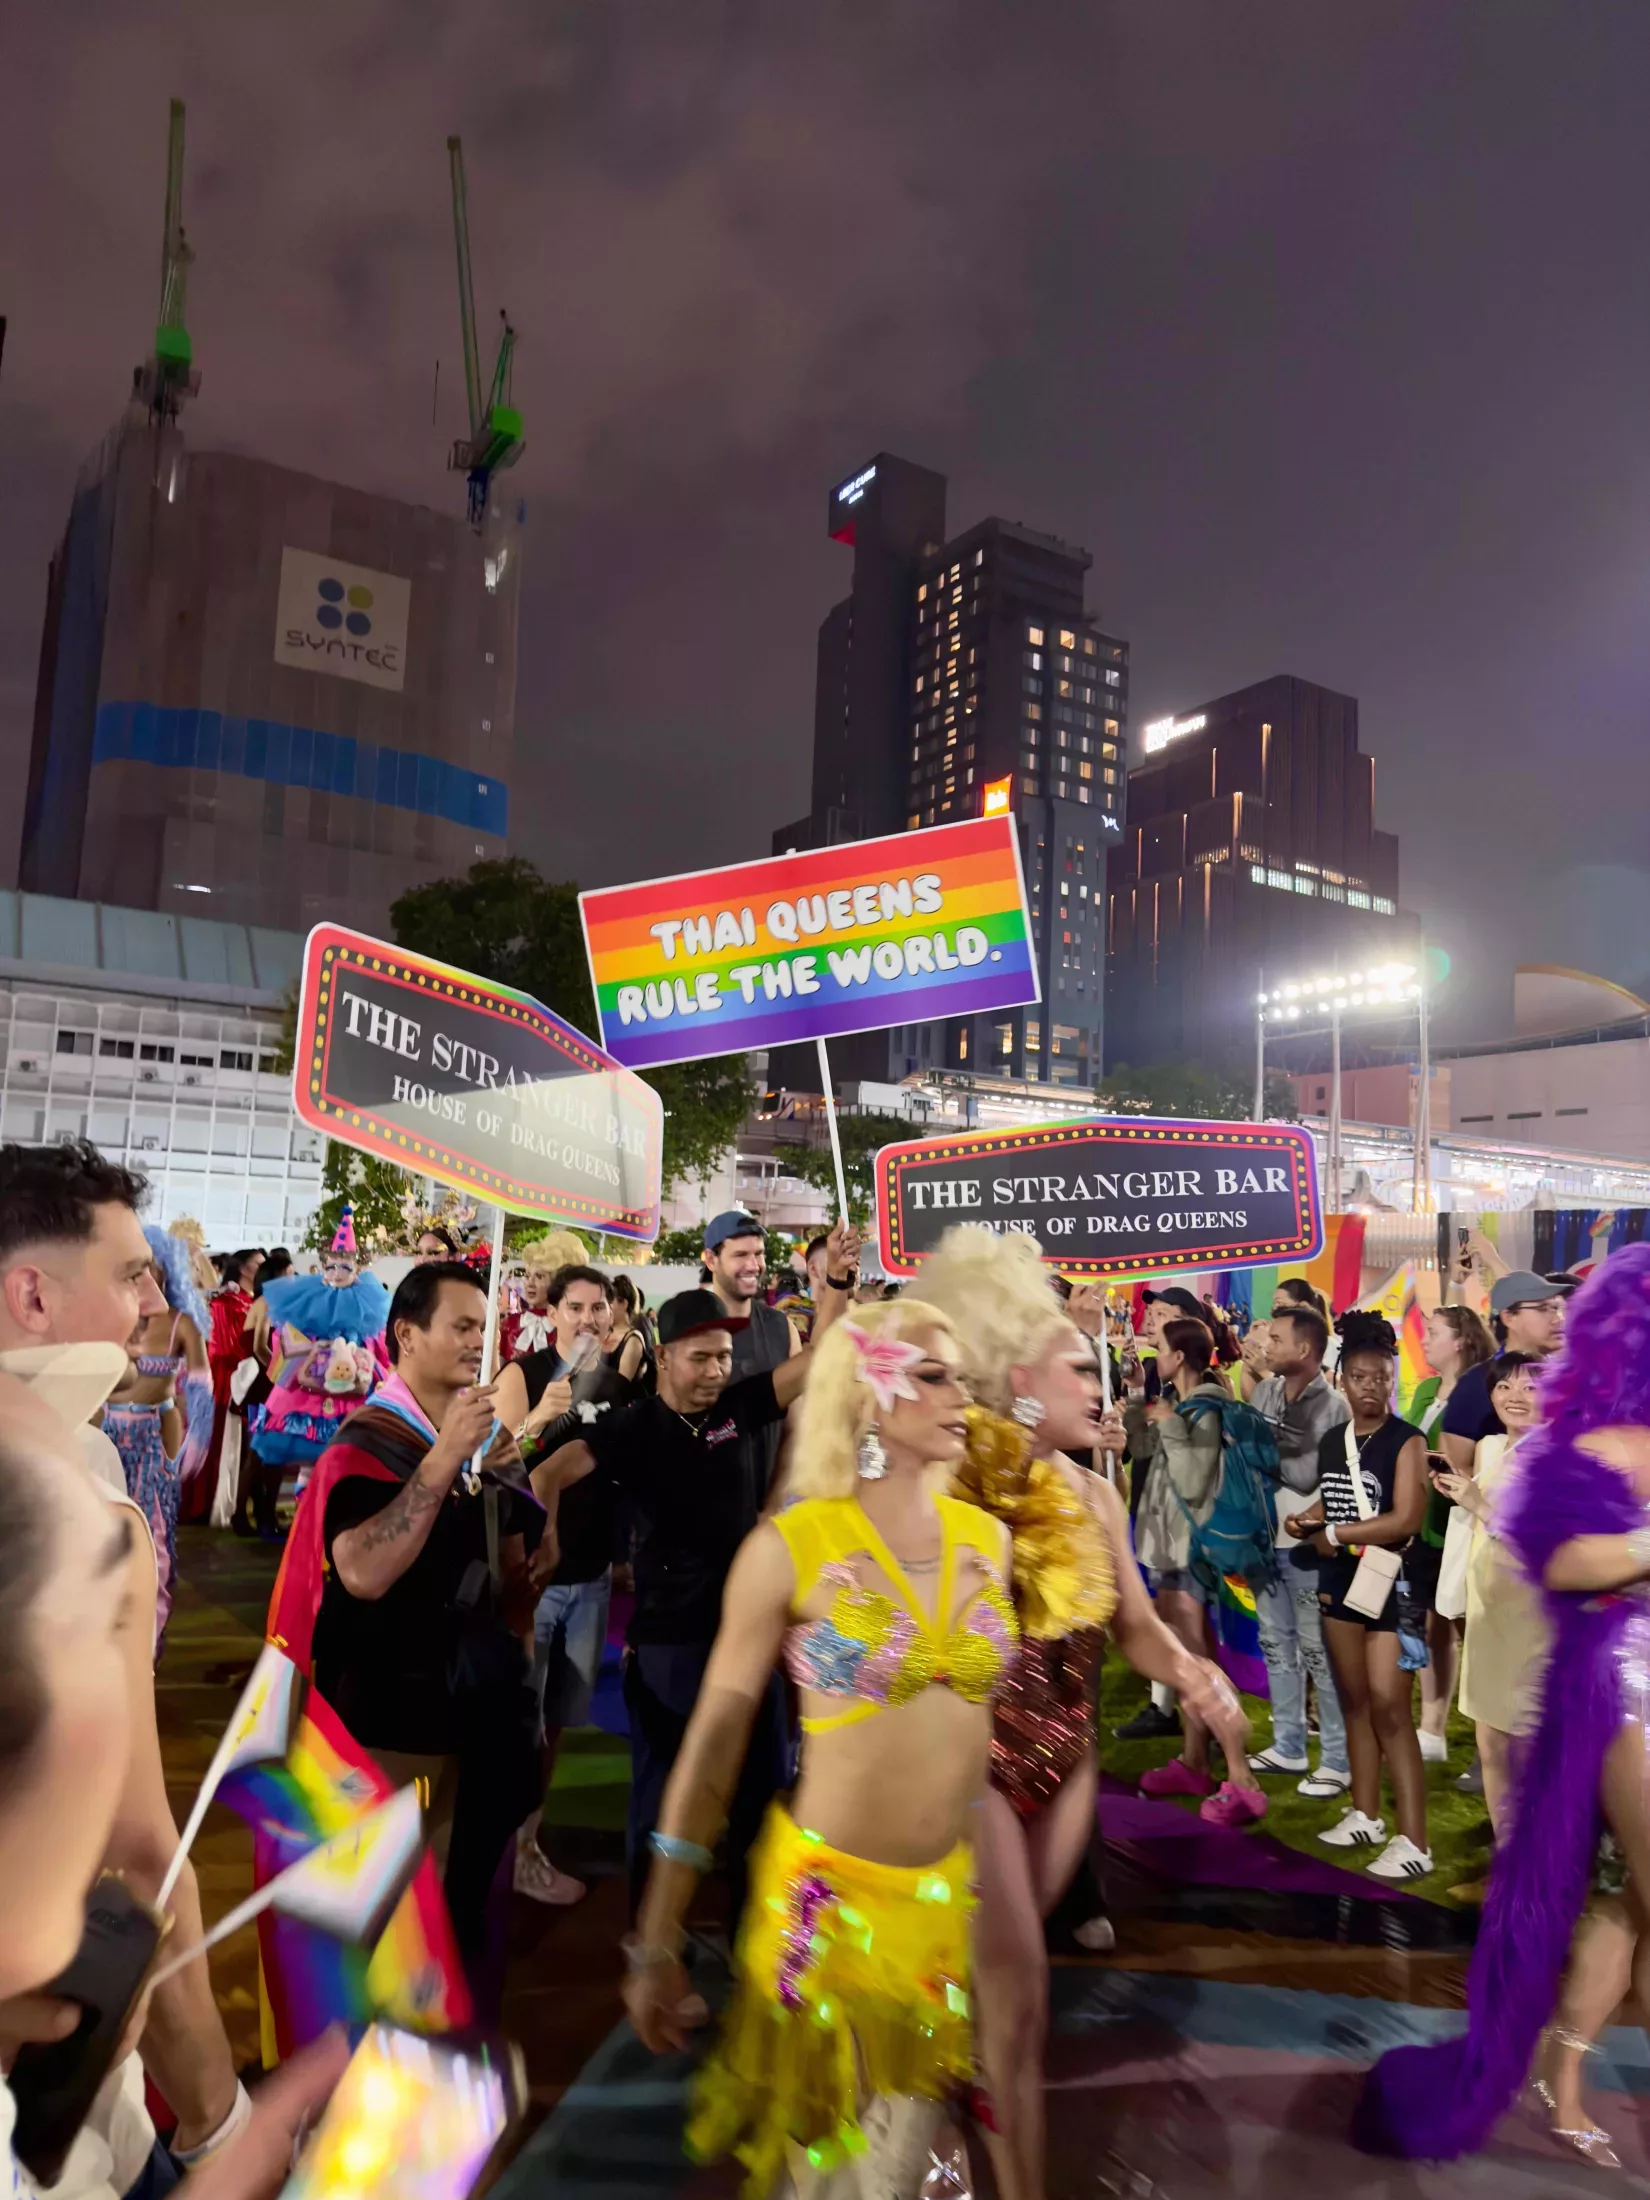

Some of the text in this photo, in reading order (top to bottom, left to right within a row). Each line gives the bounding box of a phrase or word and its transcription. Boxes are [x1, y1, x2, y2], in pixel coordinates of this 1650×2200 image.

[650, 873, 943, 960] THAI QUEENS
[616, 926, 1002, 1025] RULE THE WORLD.
[342, 991, 646, 1160] THE STRANGER BAR
[392, 1075, 620, 1186] HOUSE OF DRAG QUEENS
[907, 1167, 1290, 1209] THE STRANGER BAR
[1046, 1217, 1077, 1235] OF
[1087, 1214, 1151, 1234] DRAG
[1156, 1210, 1248, 1233] QUEENS
